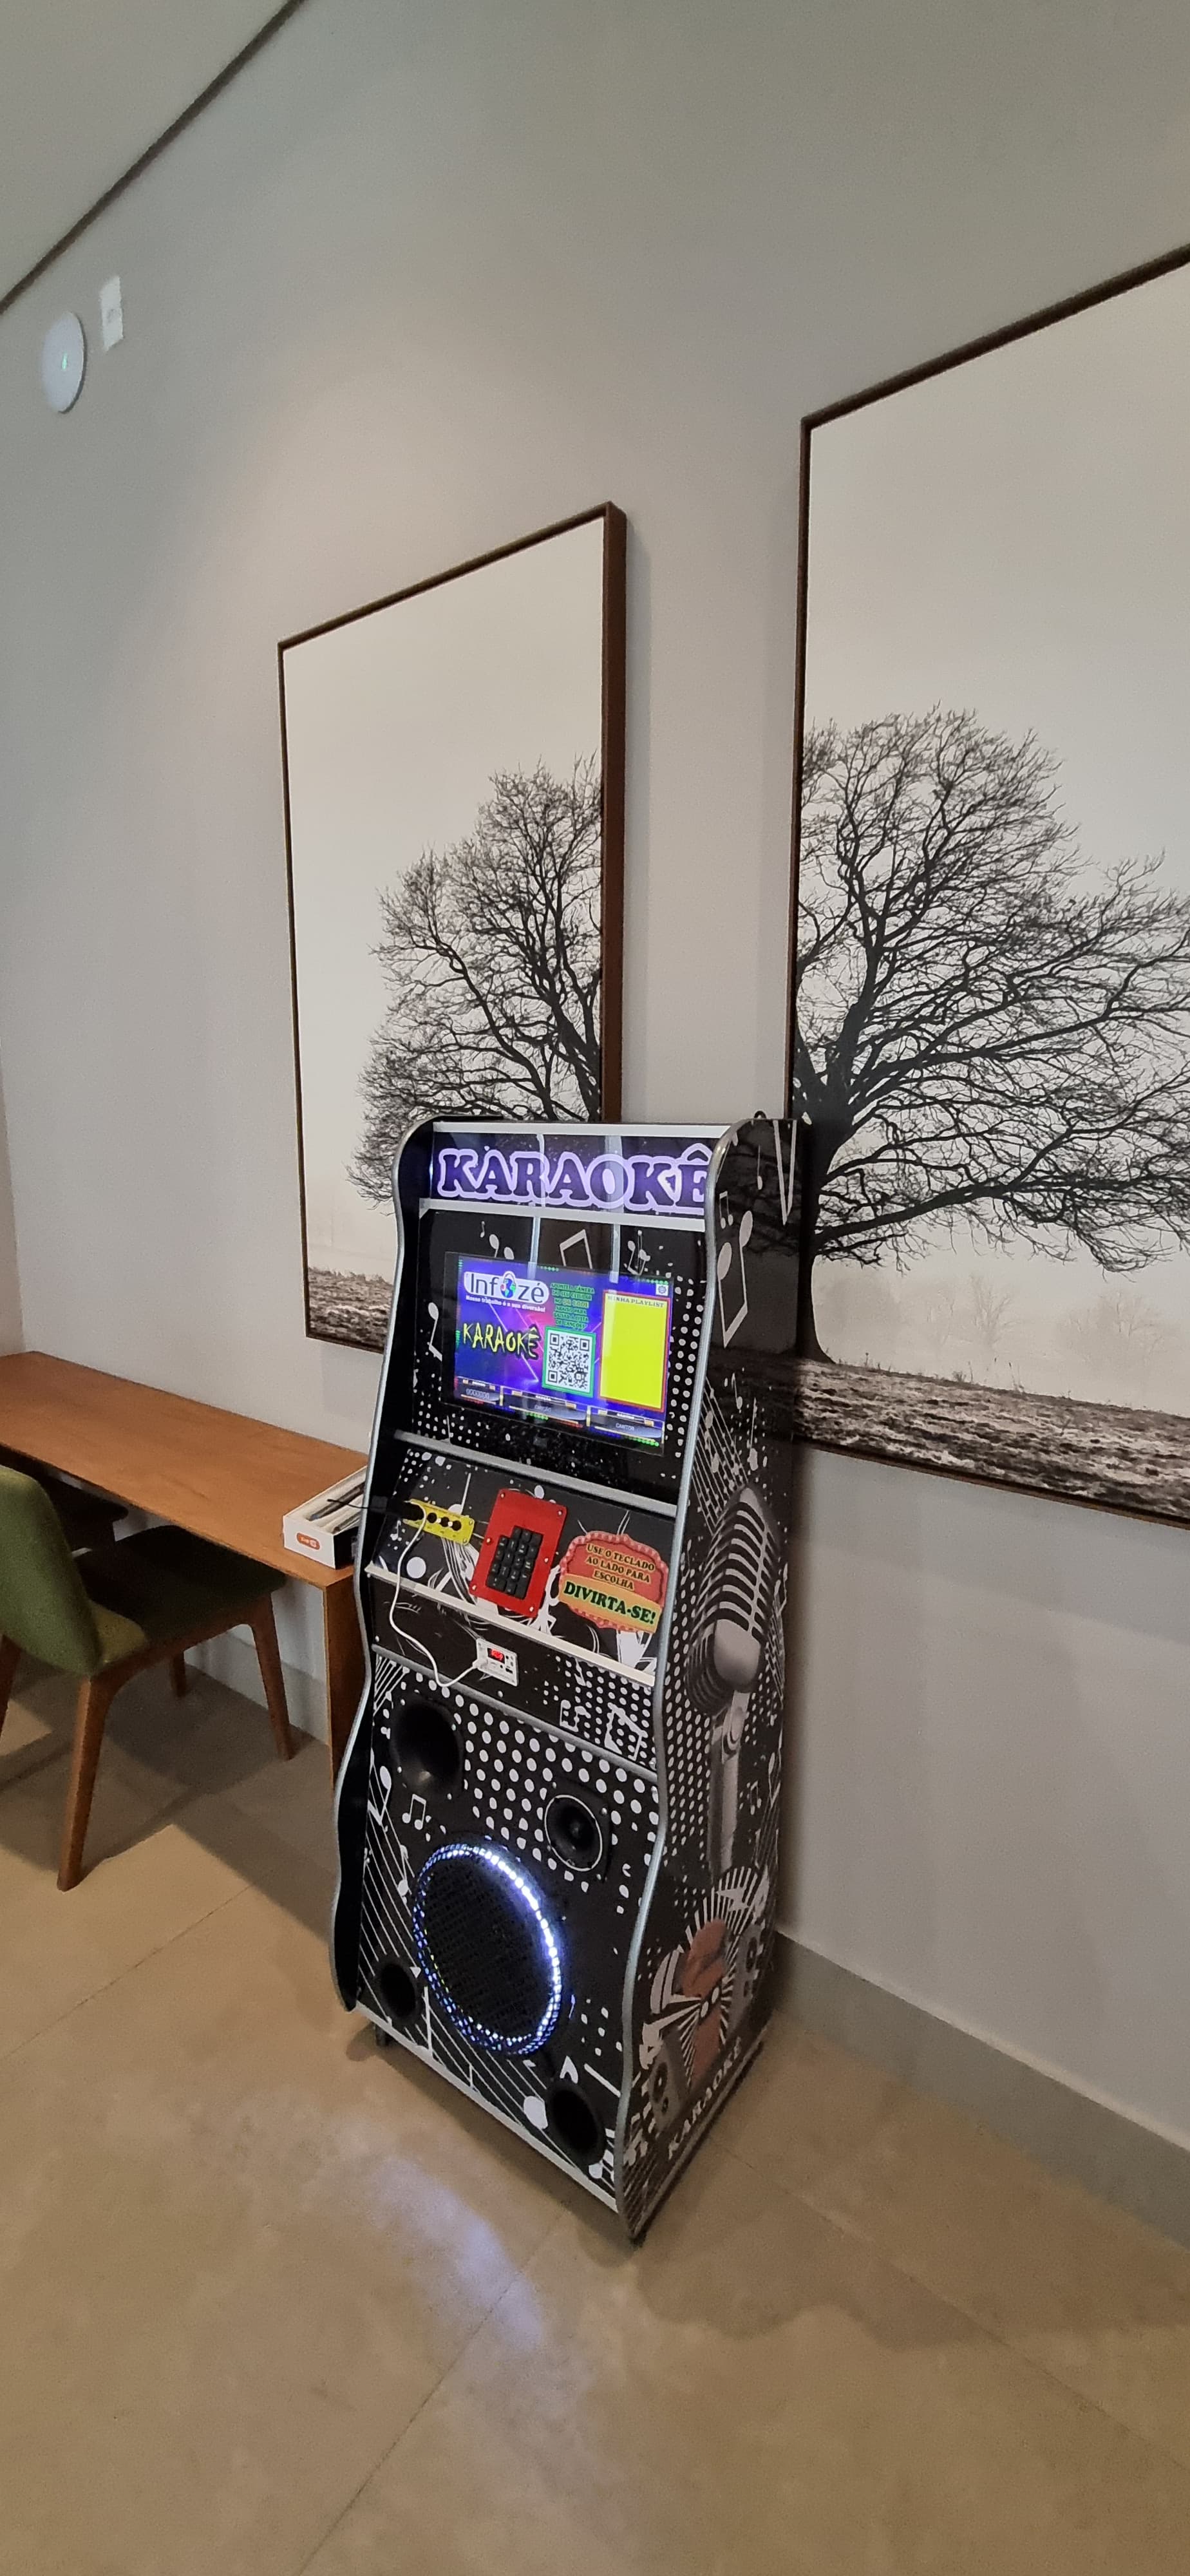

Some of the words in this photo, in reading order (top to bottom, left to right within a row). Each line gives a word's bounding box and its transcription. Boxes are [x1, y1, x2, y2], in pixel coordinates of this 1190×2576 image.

[439, 1144, 712, 1215] KARAOKÊ
[631, 1299, 664, 1307] PLAYLIST
[463, 1322, 540, 1358] KARAOKÊ
[616, 1423, 635, 1431] CANTOR
[586, 1556, 599, 1565] AO
[601, 1560, 624, 1573] LADO
[626, 1569, 650, 1583] PARA
[587, 1544, 603, 1555] USE
[614, 1553, 655, 1571] TECLADO
[594, 1570, 634, 1589] ESCOLHA
[563, 1581, 656, 1625] DIVIRTA-SE!
